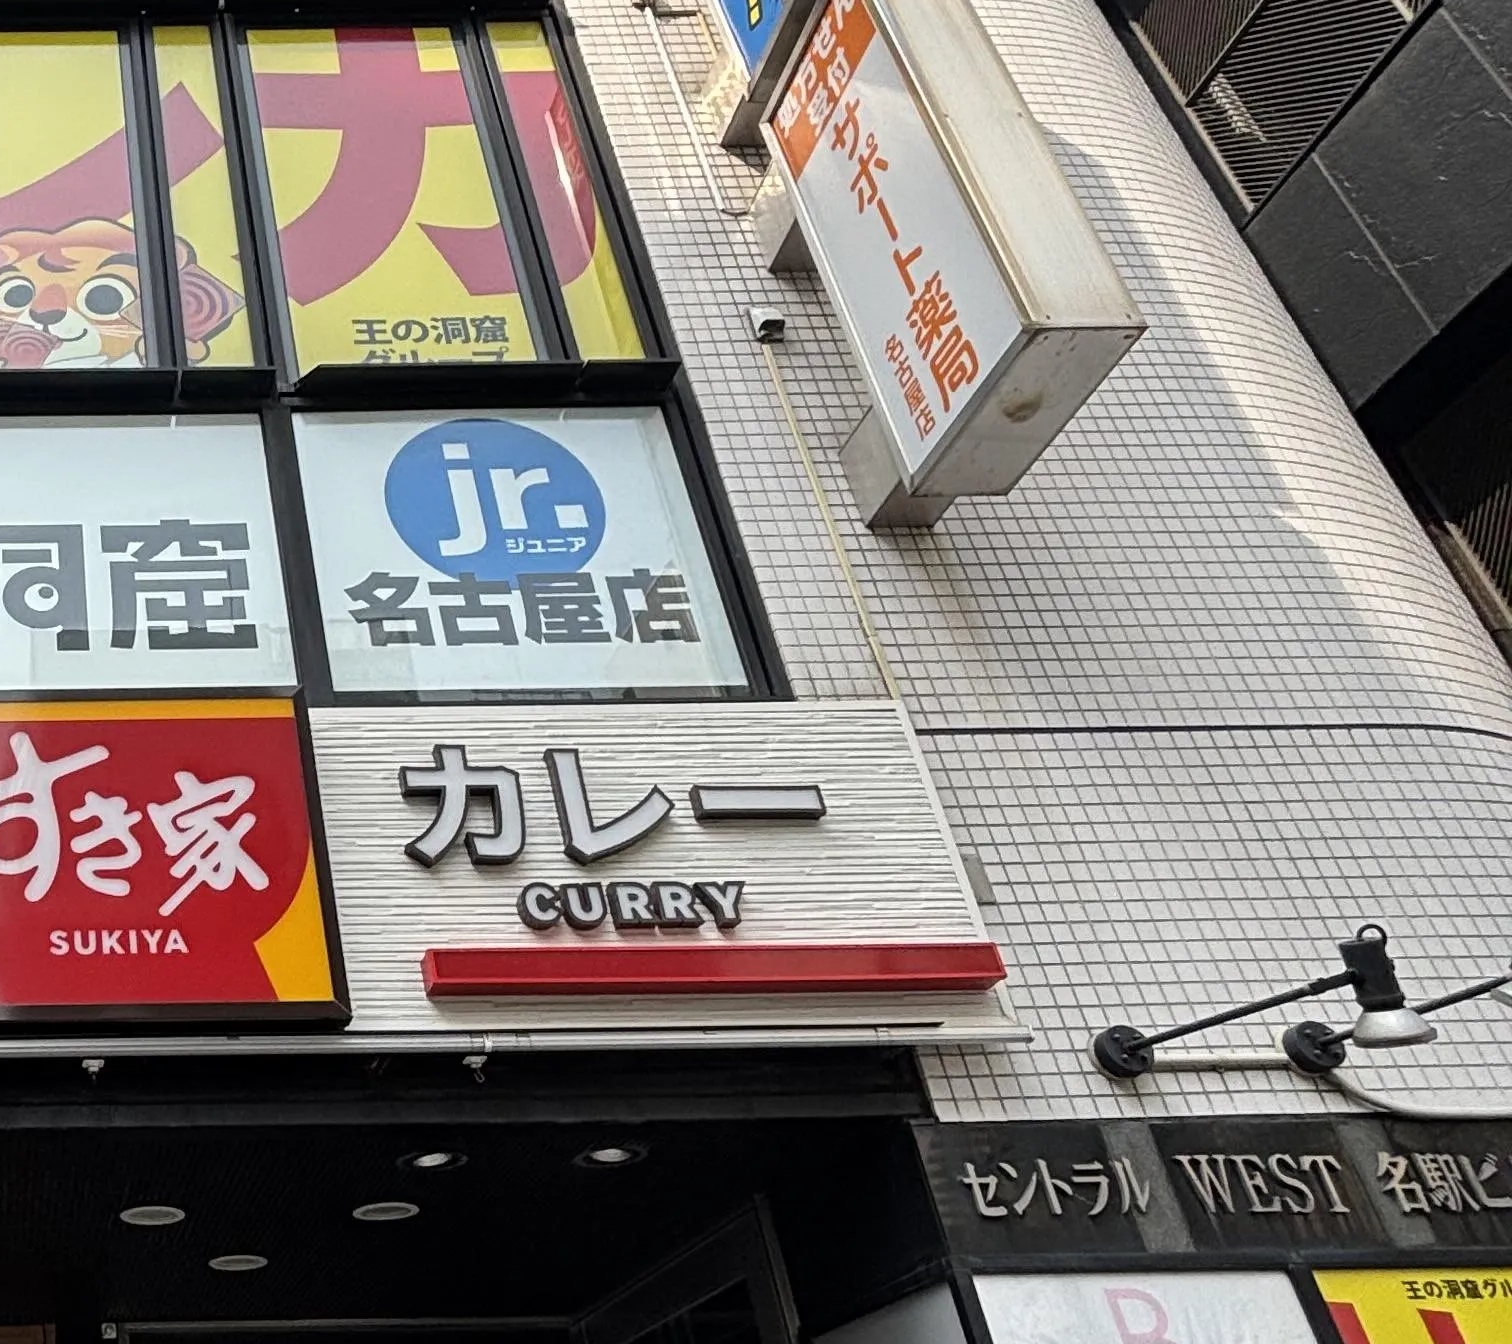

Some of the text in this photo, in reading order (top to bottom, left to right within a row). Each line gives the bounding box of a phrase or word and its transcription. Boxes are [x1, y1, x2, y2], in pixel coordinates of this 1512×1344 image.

[807, 47, 851, 137] 受付
[830, 97, 979, 414] サポート薬局
[351, 314, 510, 345] 王の洞窟
[884, 332, 937, 442] 名古屋店
[438, 442, 590, 557] jr.
[505, 535, 587, 555] ジュニア
[343, 567, 702, 647] 名古屋店
[400, 744, 829, 867] カレー
[48, 929, 191, 958] SUKIYA
[516, 880, 748, 932] CURRY
[958, 1154, 1151, 1220] セントラル
[1174, 1153, 1353, 1215] WEST
